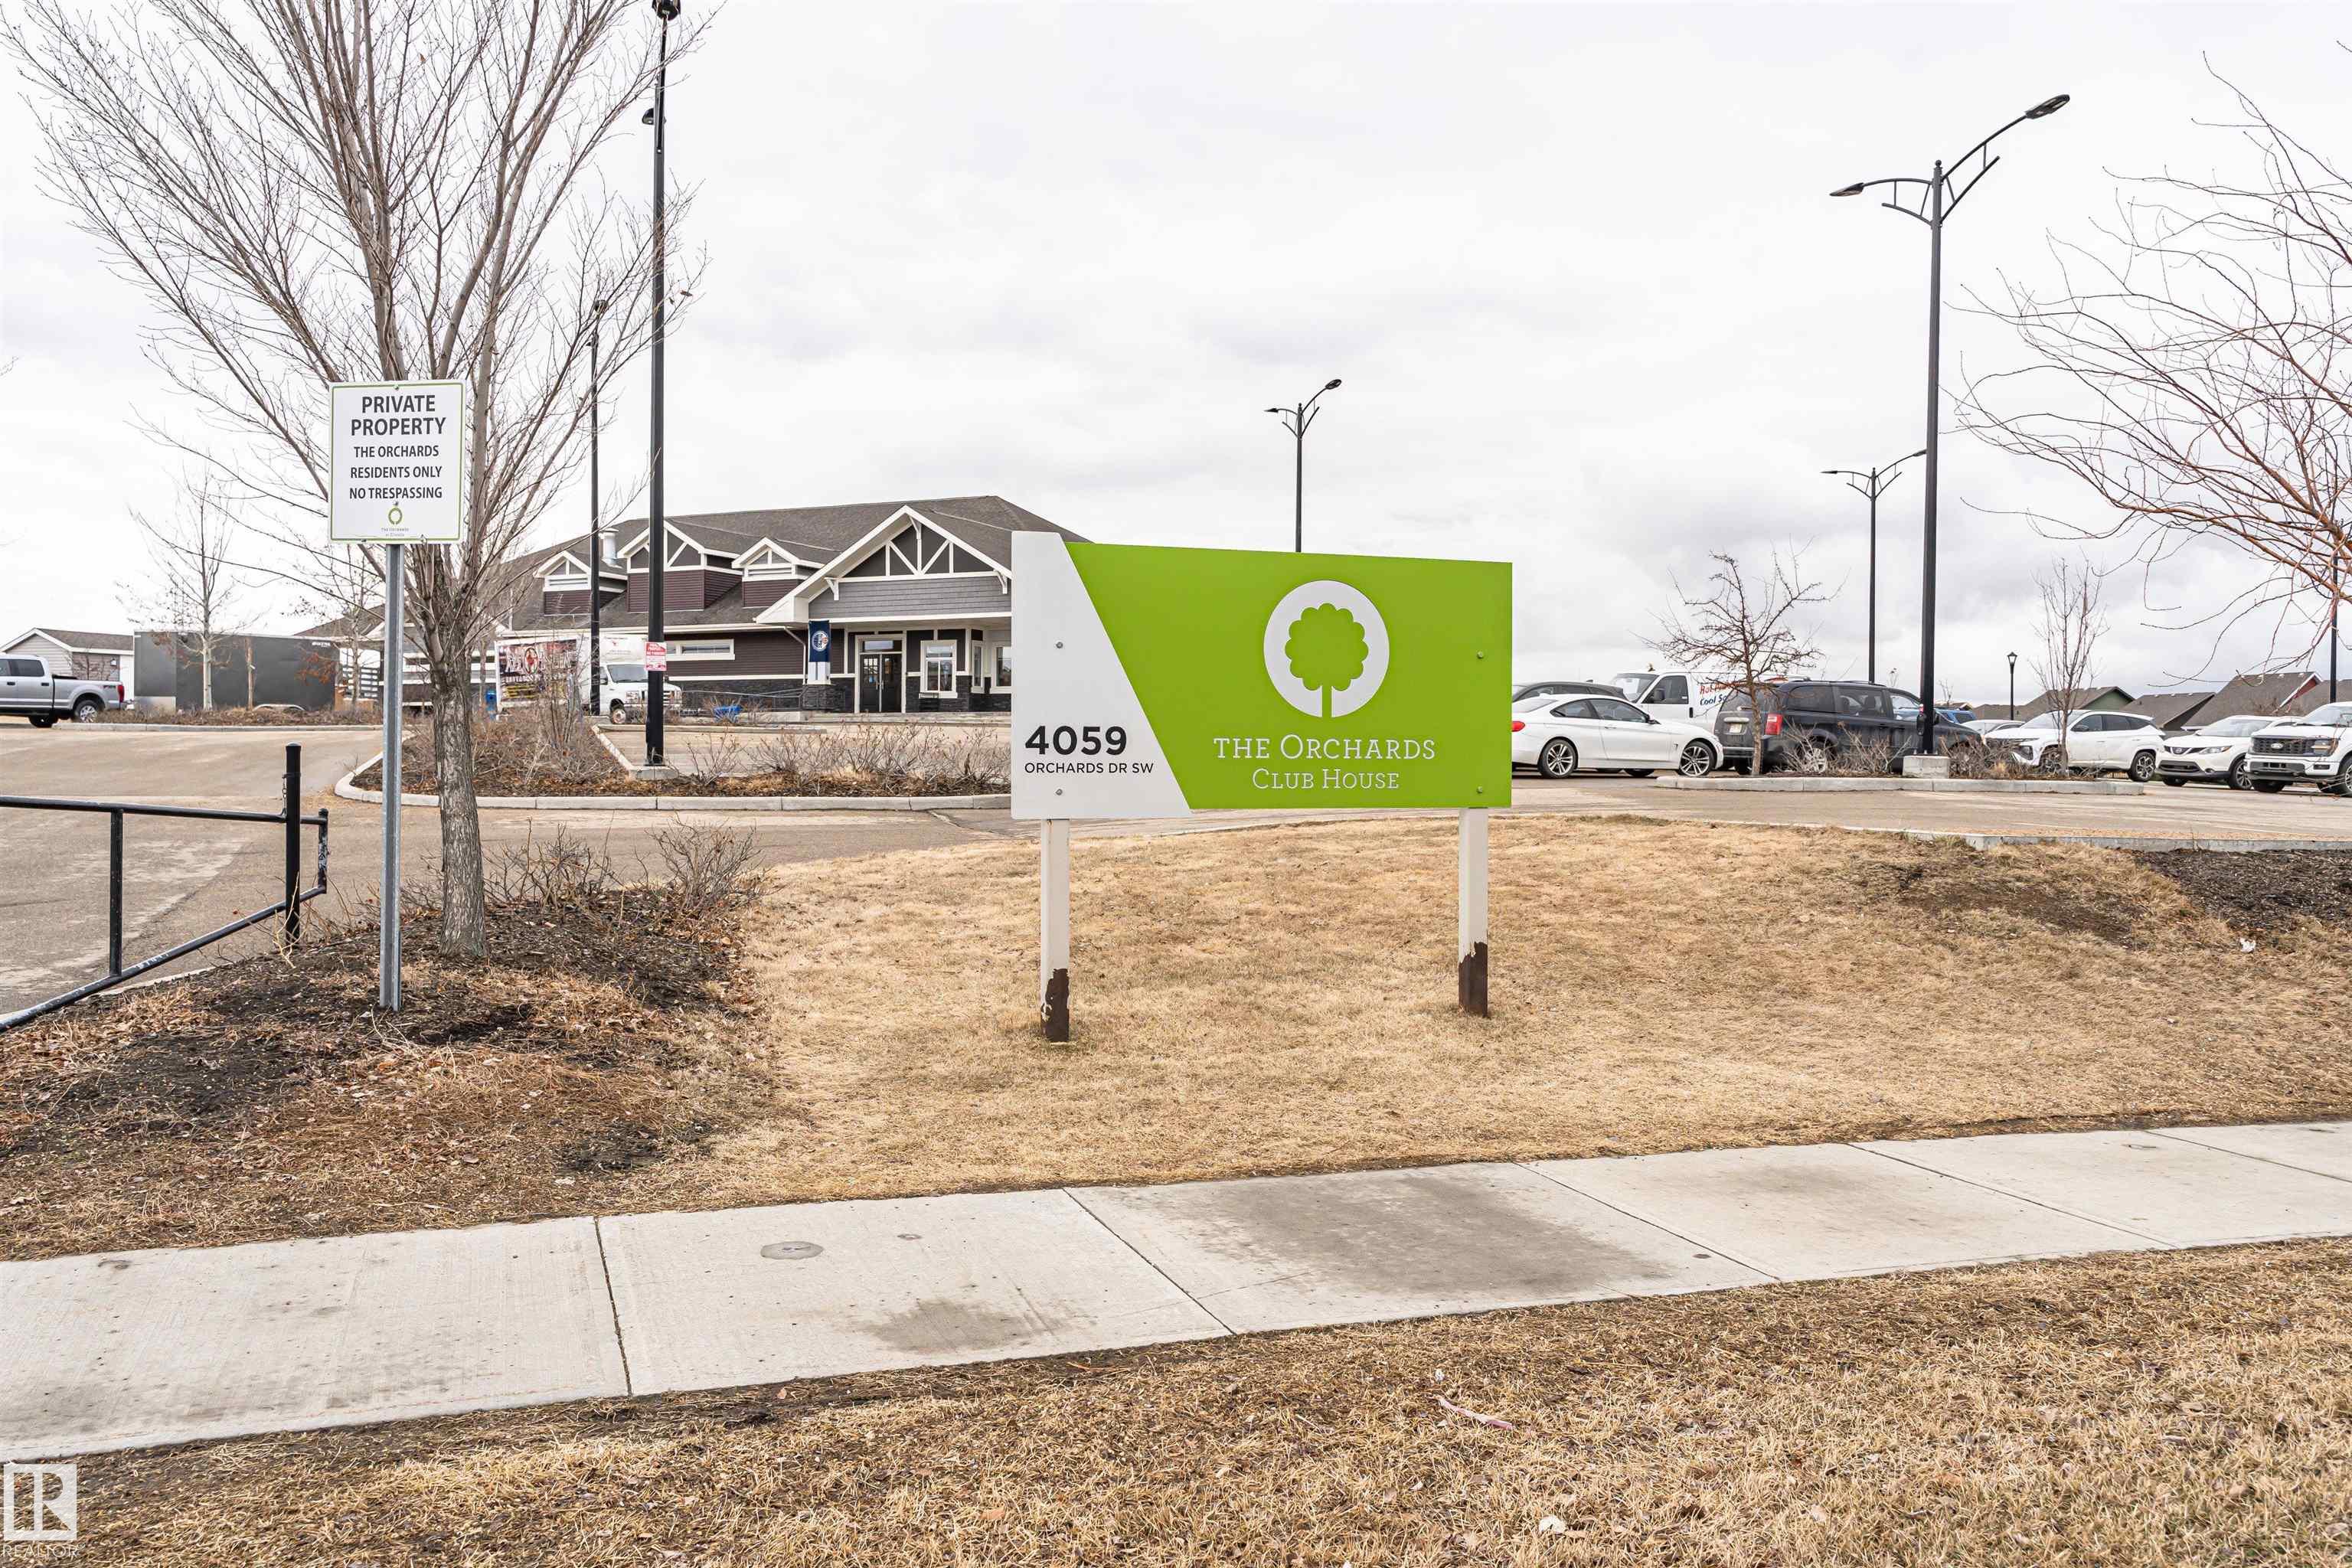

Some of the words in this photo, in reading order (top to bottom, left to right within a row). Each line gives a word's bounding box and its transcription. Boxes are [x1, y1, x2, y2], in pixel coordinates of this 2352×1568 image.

[361, 394, 436, 413] PRIVATE
[351, 416, 446, 436] PROPERTY
[354, 446, 375, 458] THE
[377, 445, 439, 457] ORCHARDS
[351, 466, 410, 479] RESIDENTS
[413, 466, 443, 478] ONLY
[349, 488, 366, 499] NO
[368, 487, 443, 498] TRESPASSING
[1024, 725, 1127, 756] 4059
[1213, 737, 1270, 759] THE
[1280, 733, 1436, 760] ORCHARDS
[1024, 763, 1104, 773] ORCHARDS
[1109, 763, 1128, 773] DR
[1132, 763, 1154, 773] SW
[1252, 768, 1315, 789] CLUB
[1321, 768, 1400, 789] HOUSE
